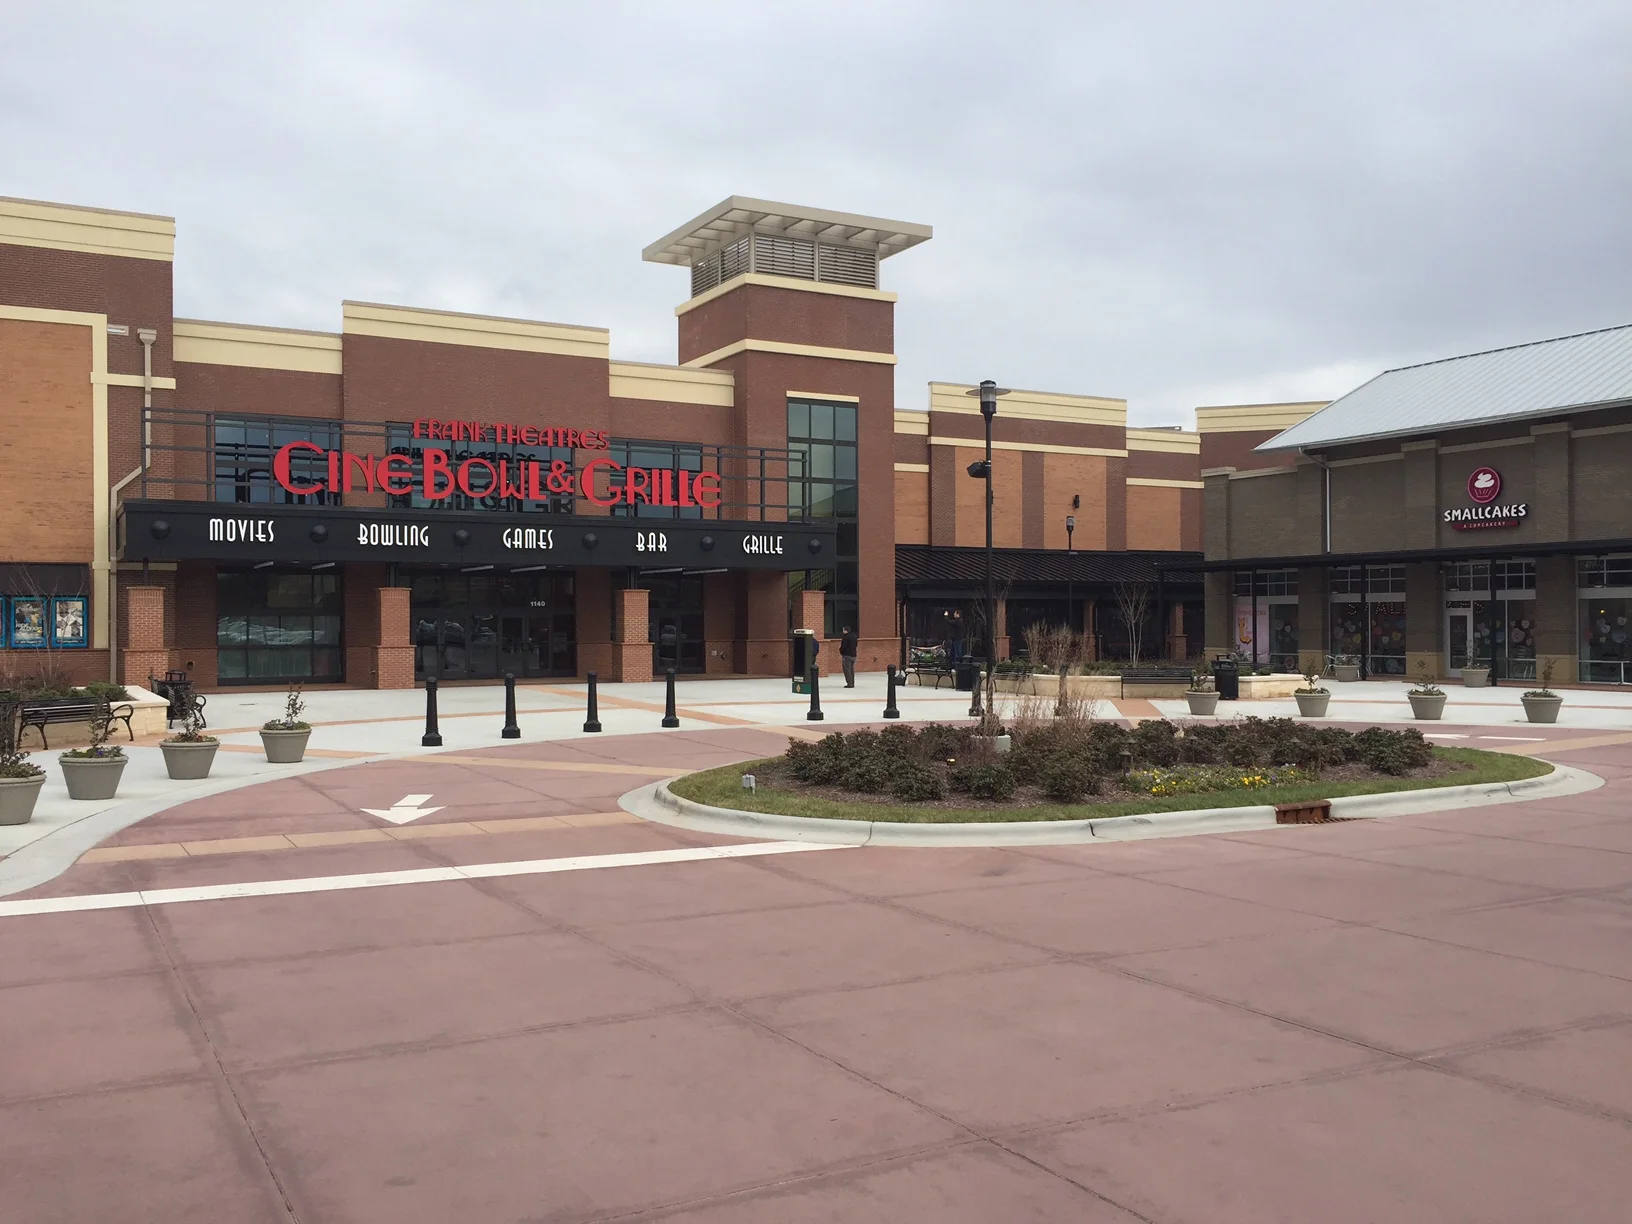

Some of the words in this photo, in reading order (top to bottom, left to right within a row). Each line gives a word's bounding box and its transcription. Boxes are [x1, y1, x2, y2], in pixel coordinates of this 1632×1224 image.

[412, 418, 487, 442] FRANK
[491, 422, 609, 449] THEATRES
[581, 458, 722, 508] GRILLE
[1444, 504, 1526, 522] SMALLCAKES
[209, 518, 274, 543] MOVIES
[357, 523, 429, 547] BOWLING
[502, 528, 553, 549] GAMES
[636, 532, 667, 552] BAR
[743, 535, 783, 554] GRILLE
